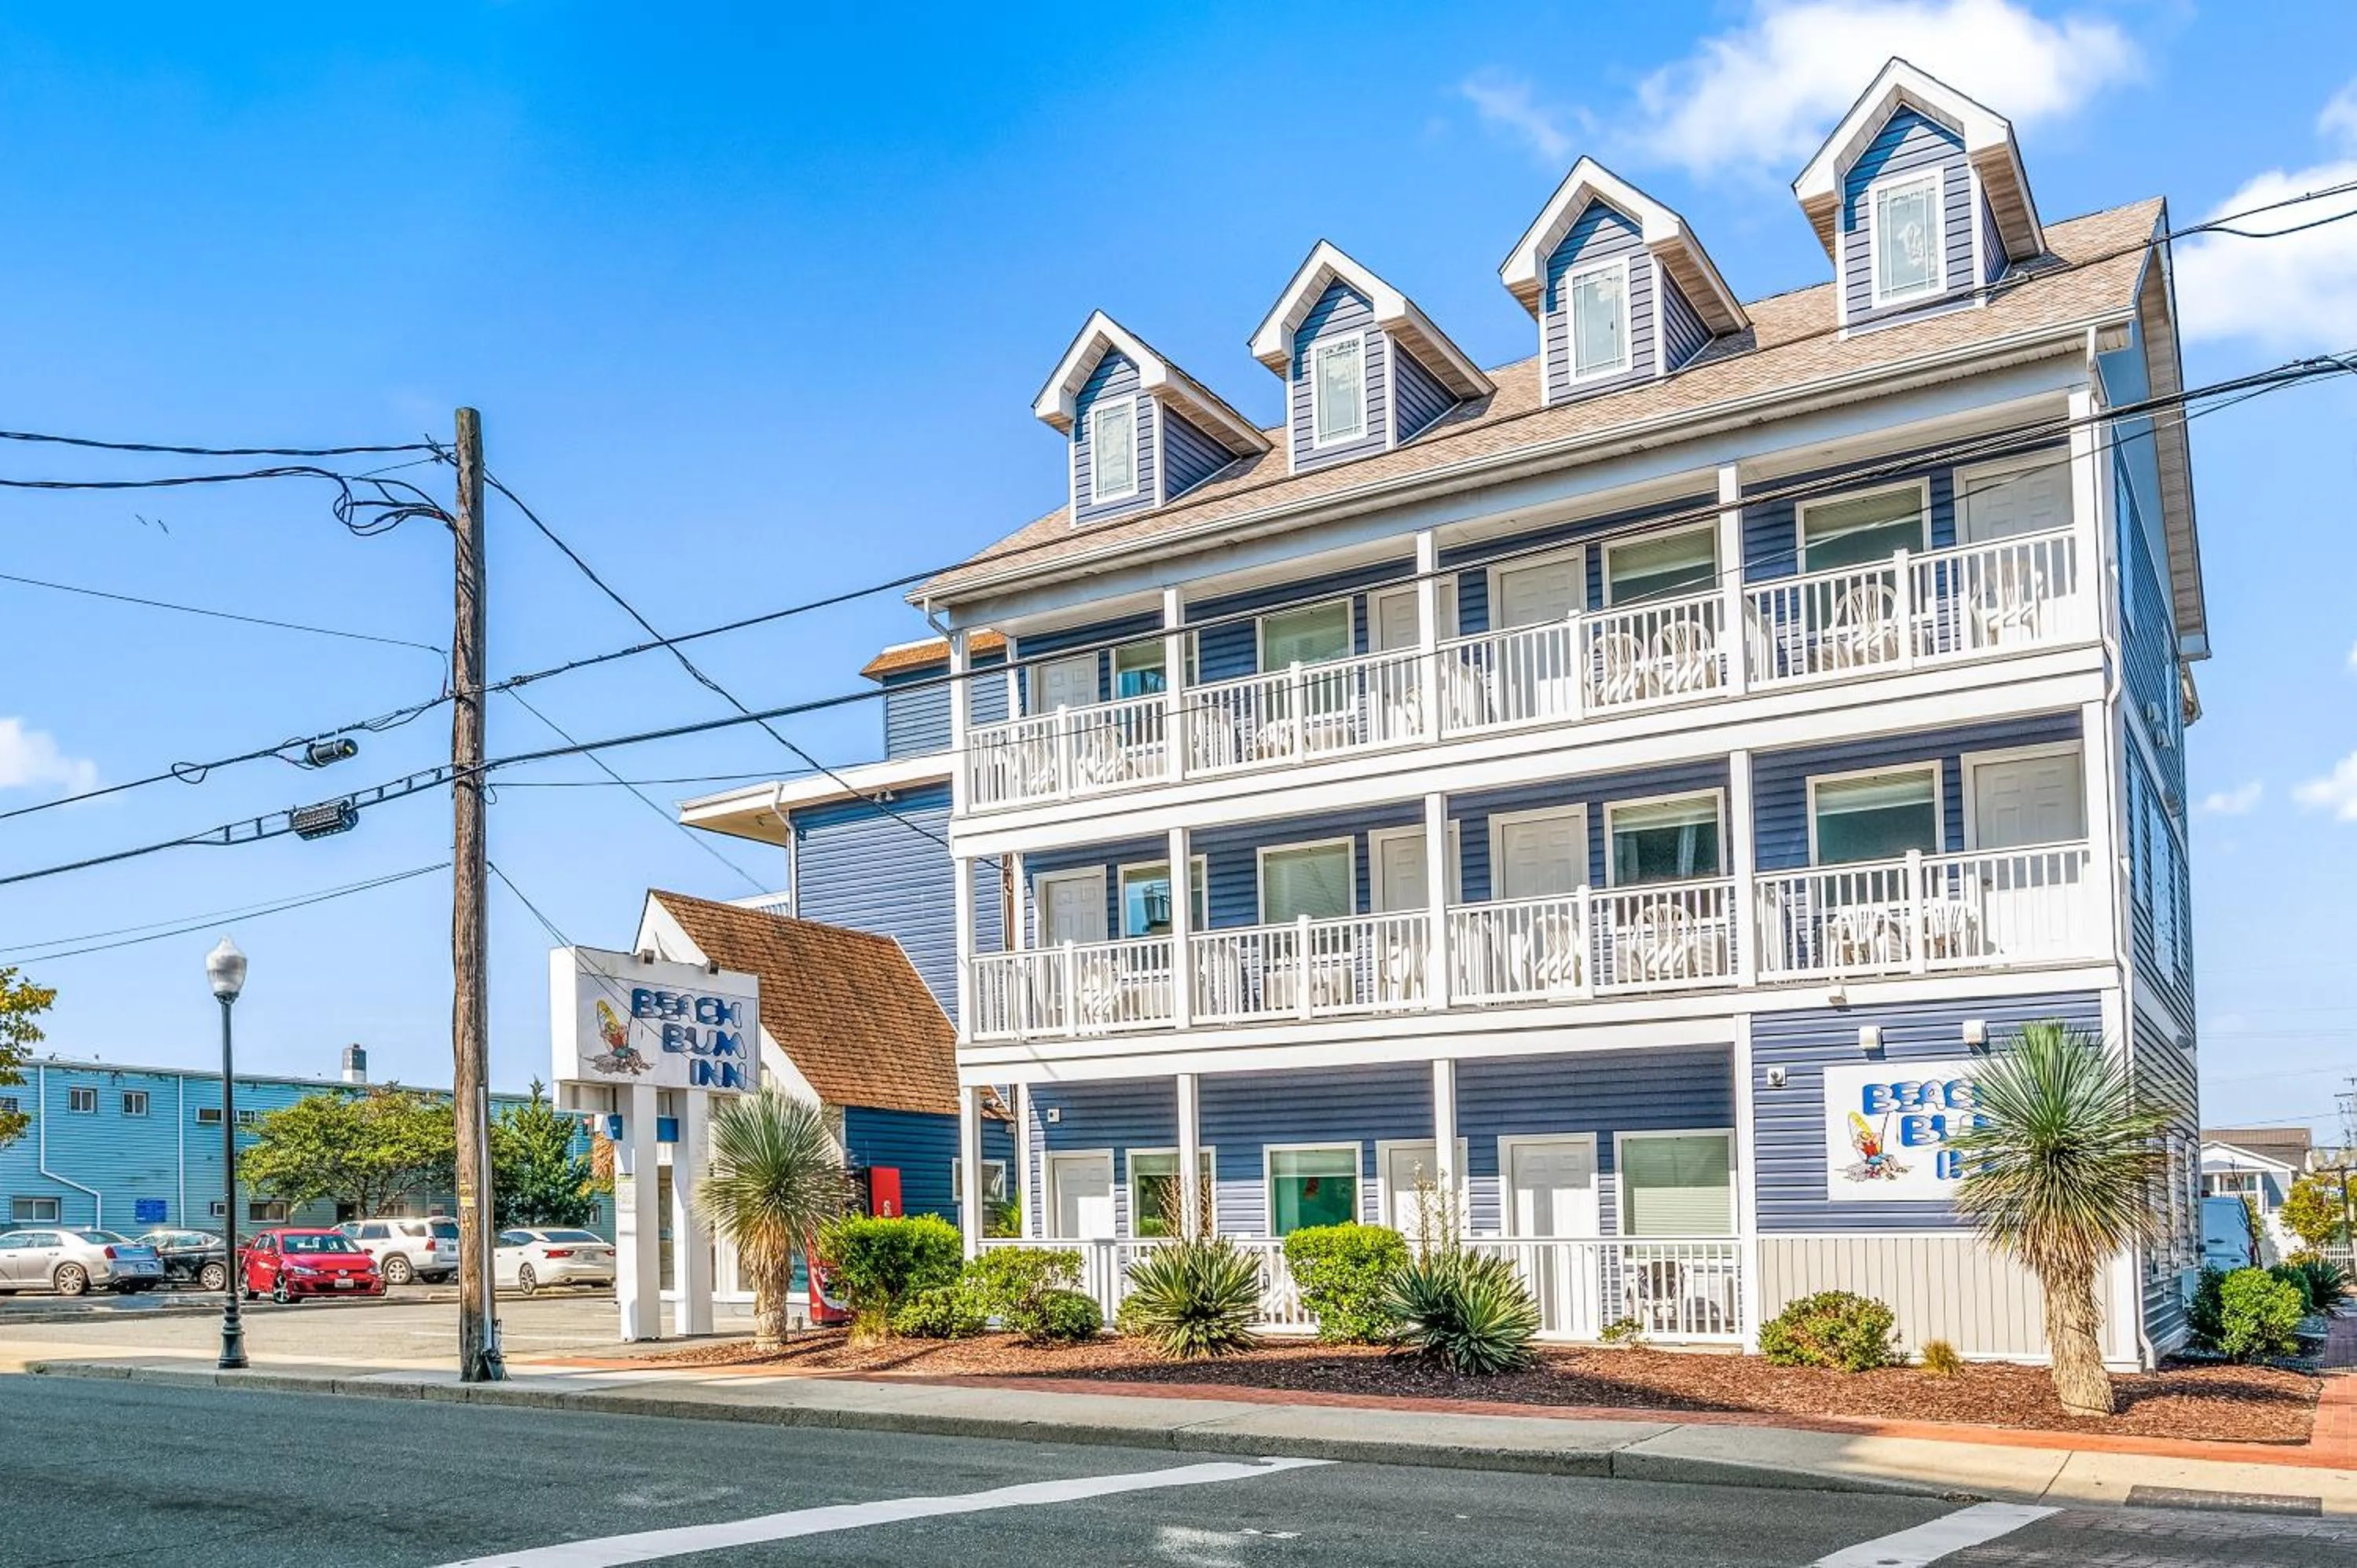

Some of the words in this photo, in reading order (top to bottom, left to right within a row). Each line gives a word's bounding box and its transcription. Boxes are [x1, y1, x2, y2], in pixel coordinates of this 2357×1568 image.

[631, 987, 742, 1028] BEACH
[662, 1023, 747, 1059] BUM
[690, 1059, 747, 1090] INN
